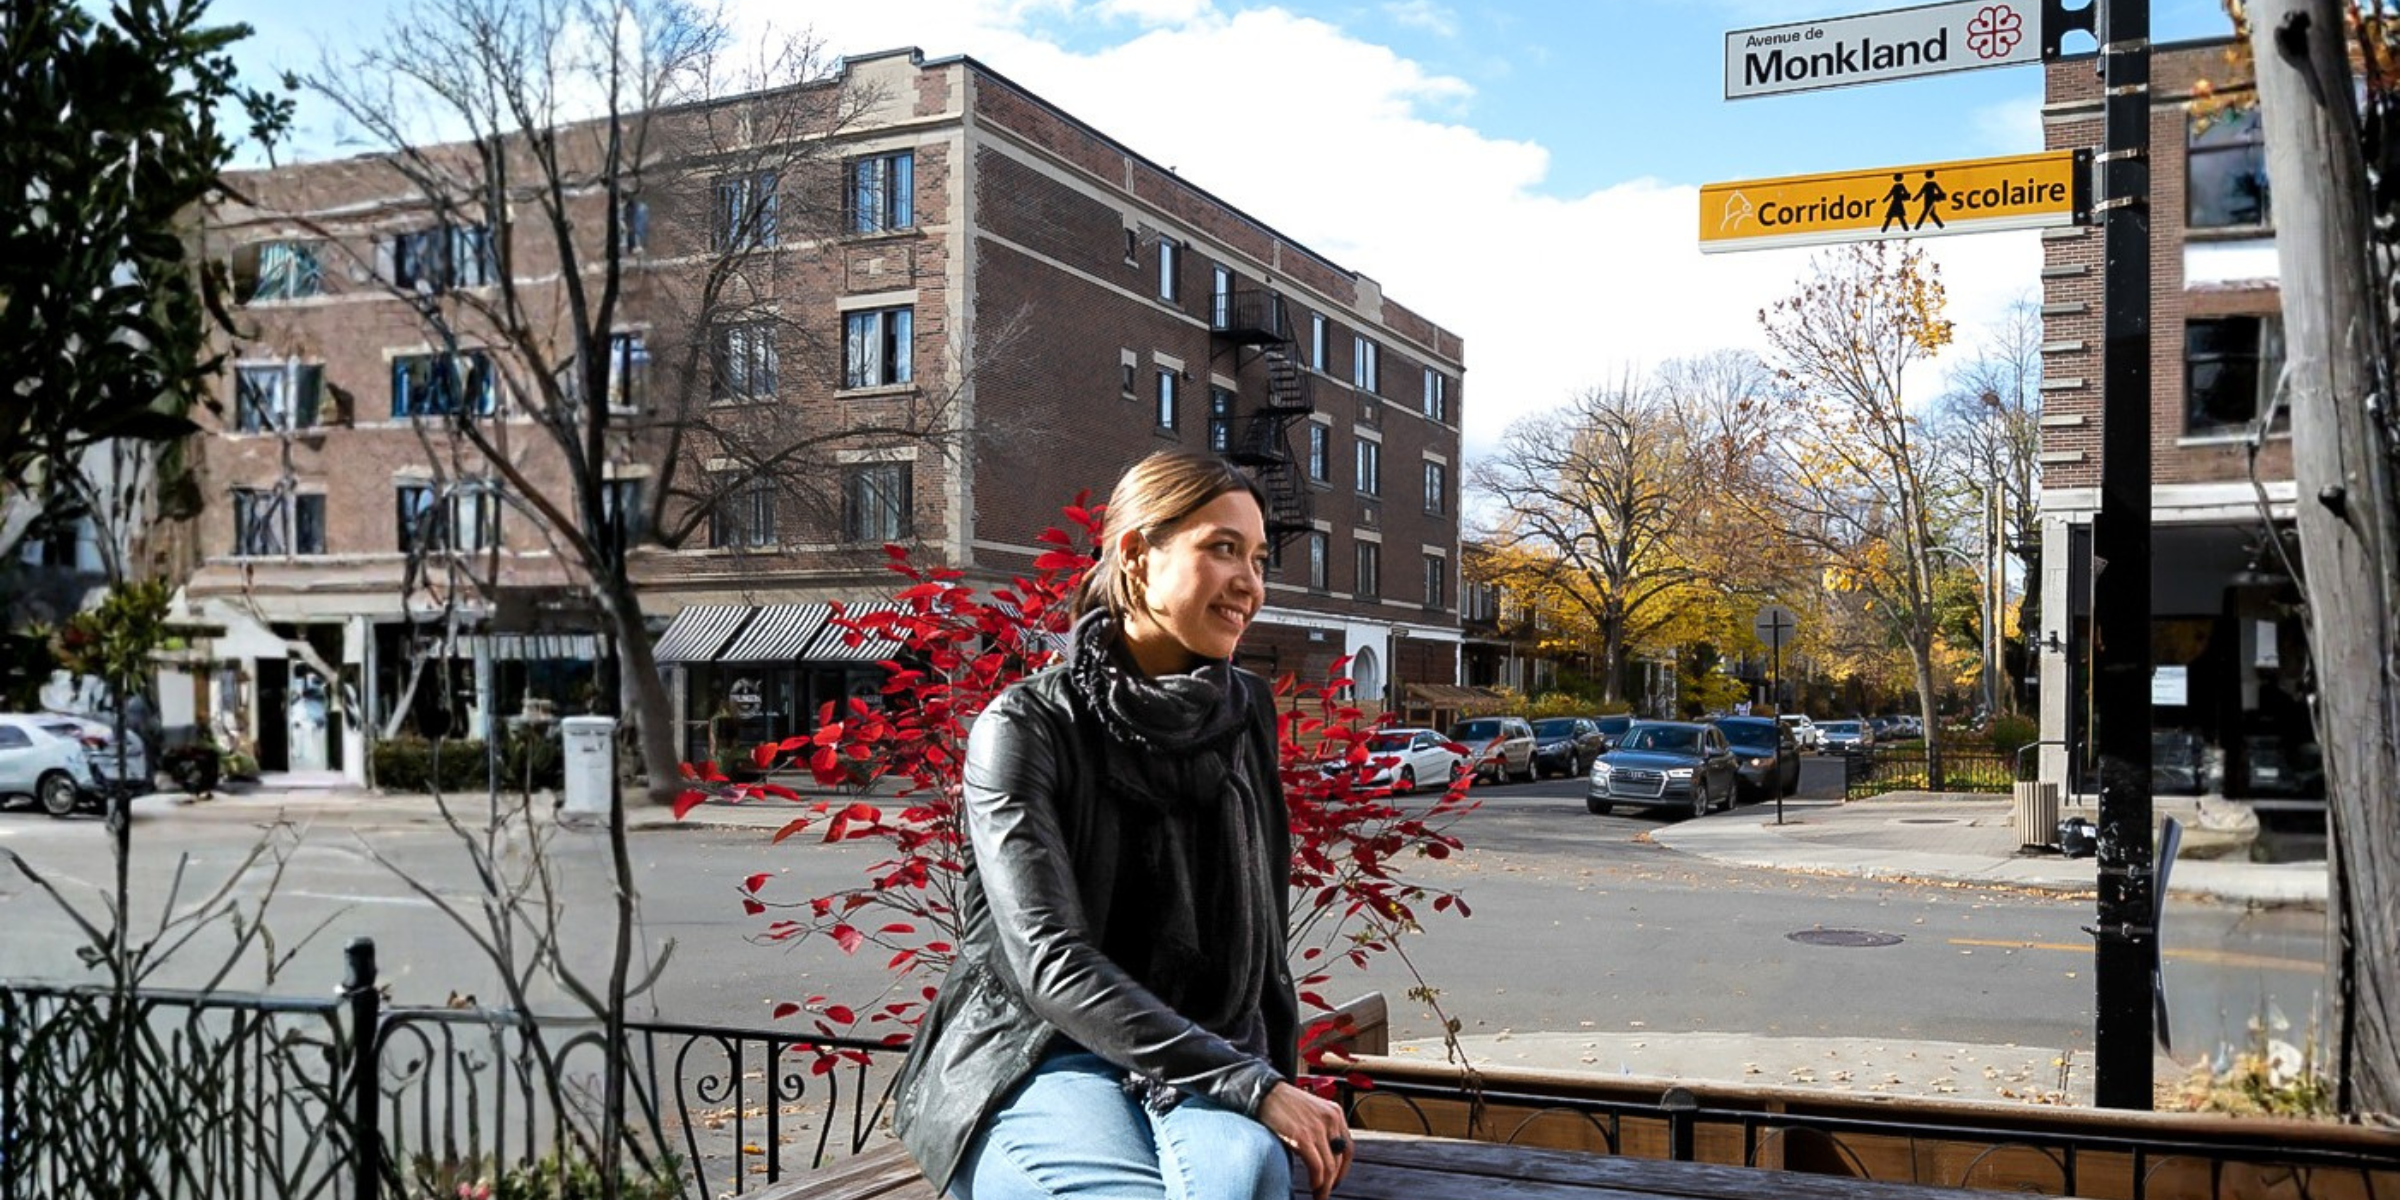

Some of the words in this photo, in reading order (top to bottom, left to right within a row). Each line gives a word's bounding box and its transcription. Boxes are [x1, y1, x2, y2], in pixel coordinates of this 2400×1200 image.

[1745, 32, 1800, 48] Avenue
[1805, 27, 1824, 41] de
[1745, 27, 1947, 86] Monkland
[1757, 194, 1877, 226] Corridor
[1951, 178, 2065, 211] scolaire
